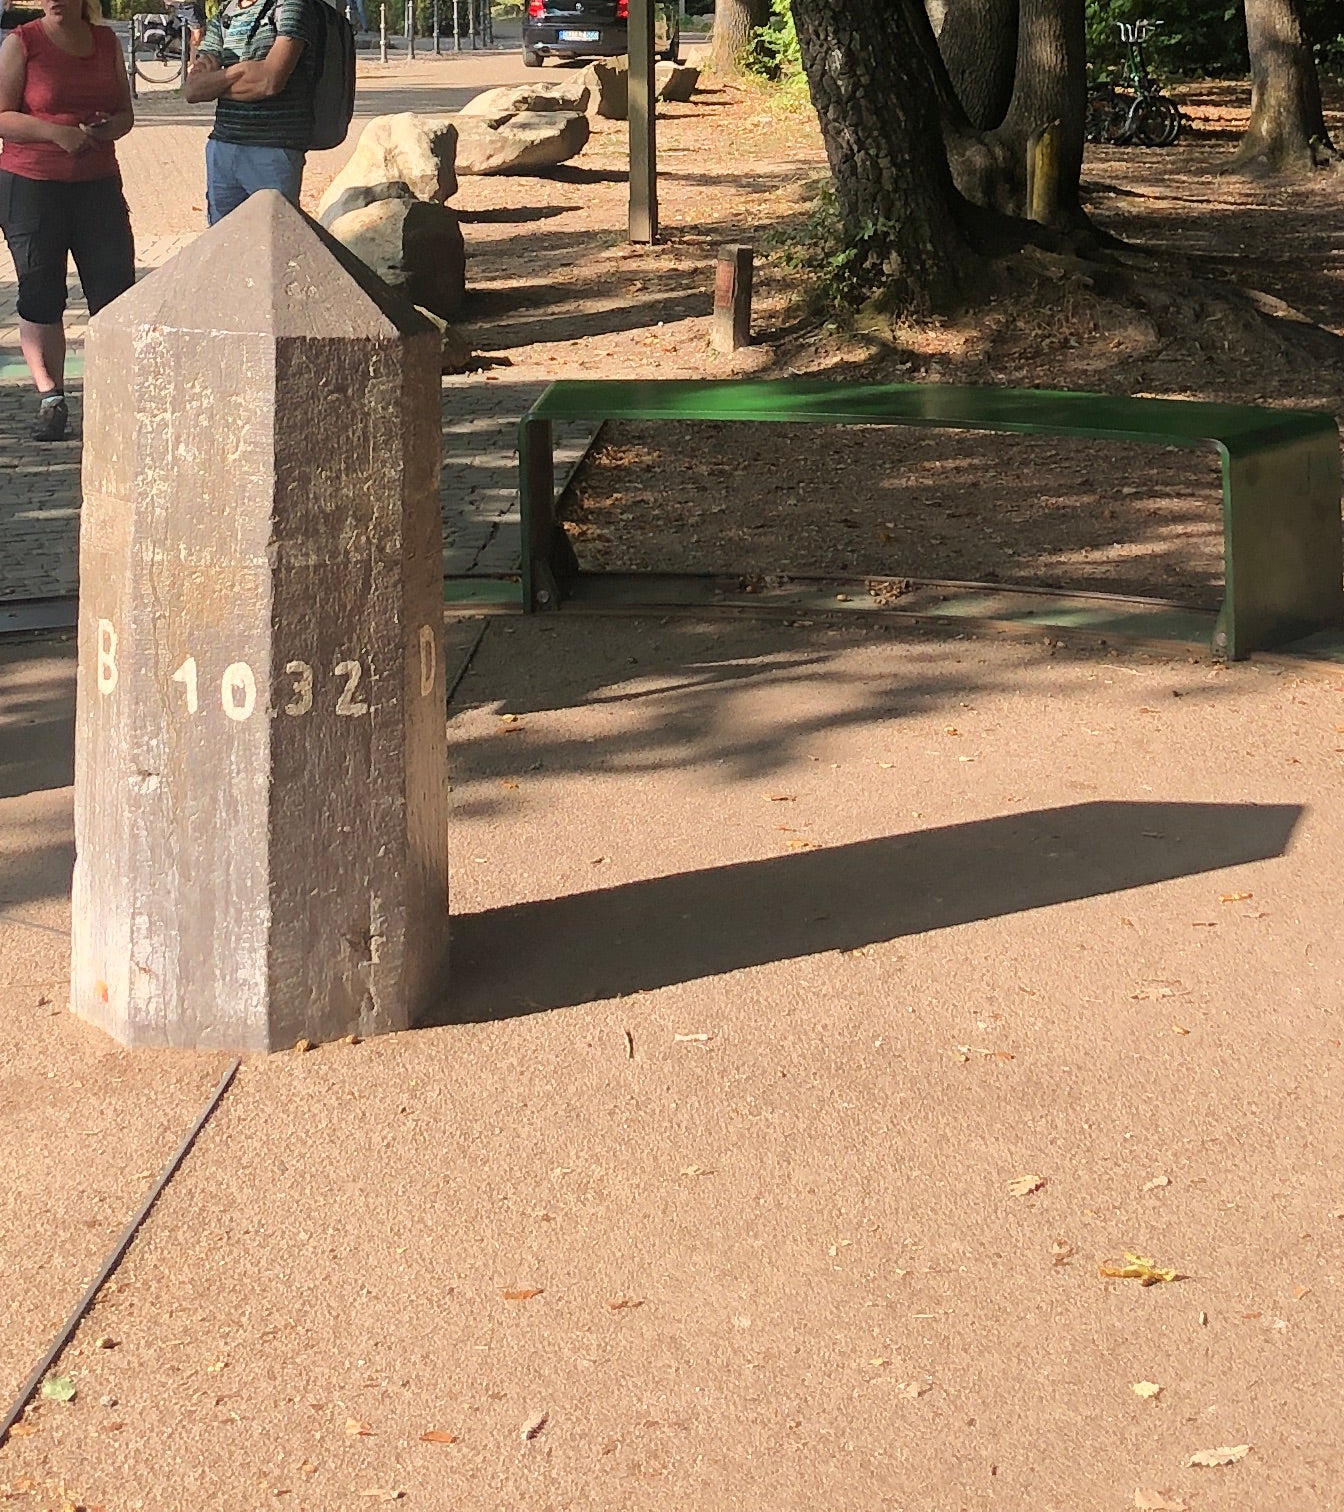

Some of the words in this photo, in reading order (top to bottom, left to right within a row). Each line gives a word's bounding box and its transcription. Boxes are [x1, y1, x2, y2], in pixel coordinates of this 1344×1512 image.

[97, 617, 119, 696] B
[172, 657, 369, 722] 1032
[419, 624, 437, 697] D
